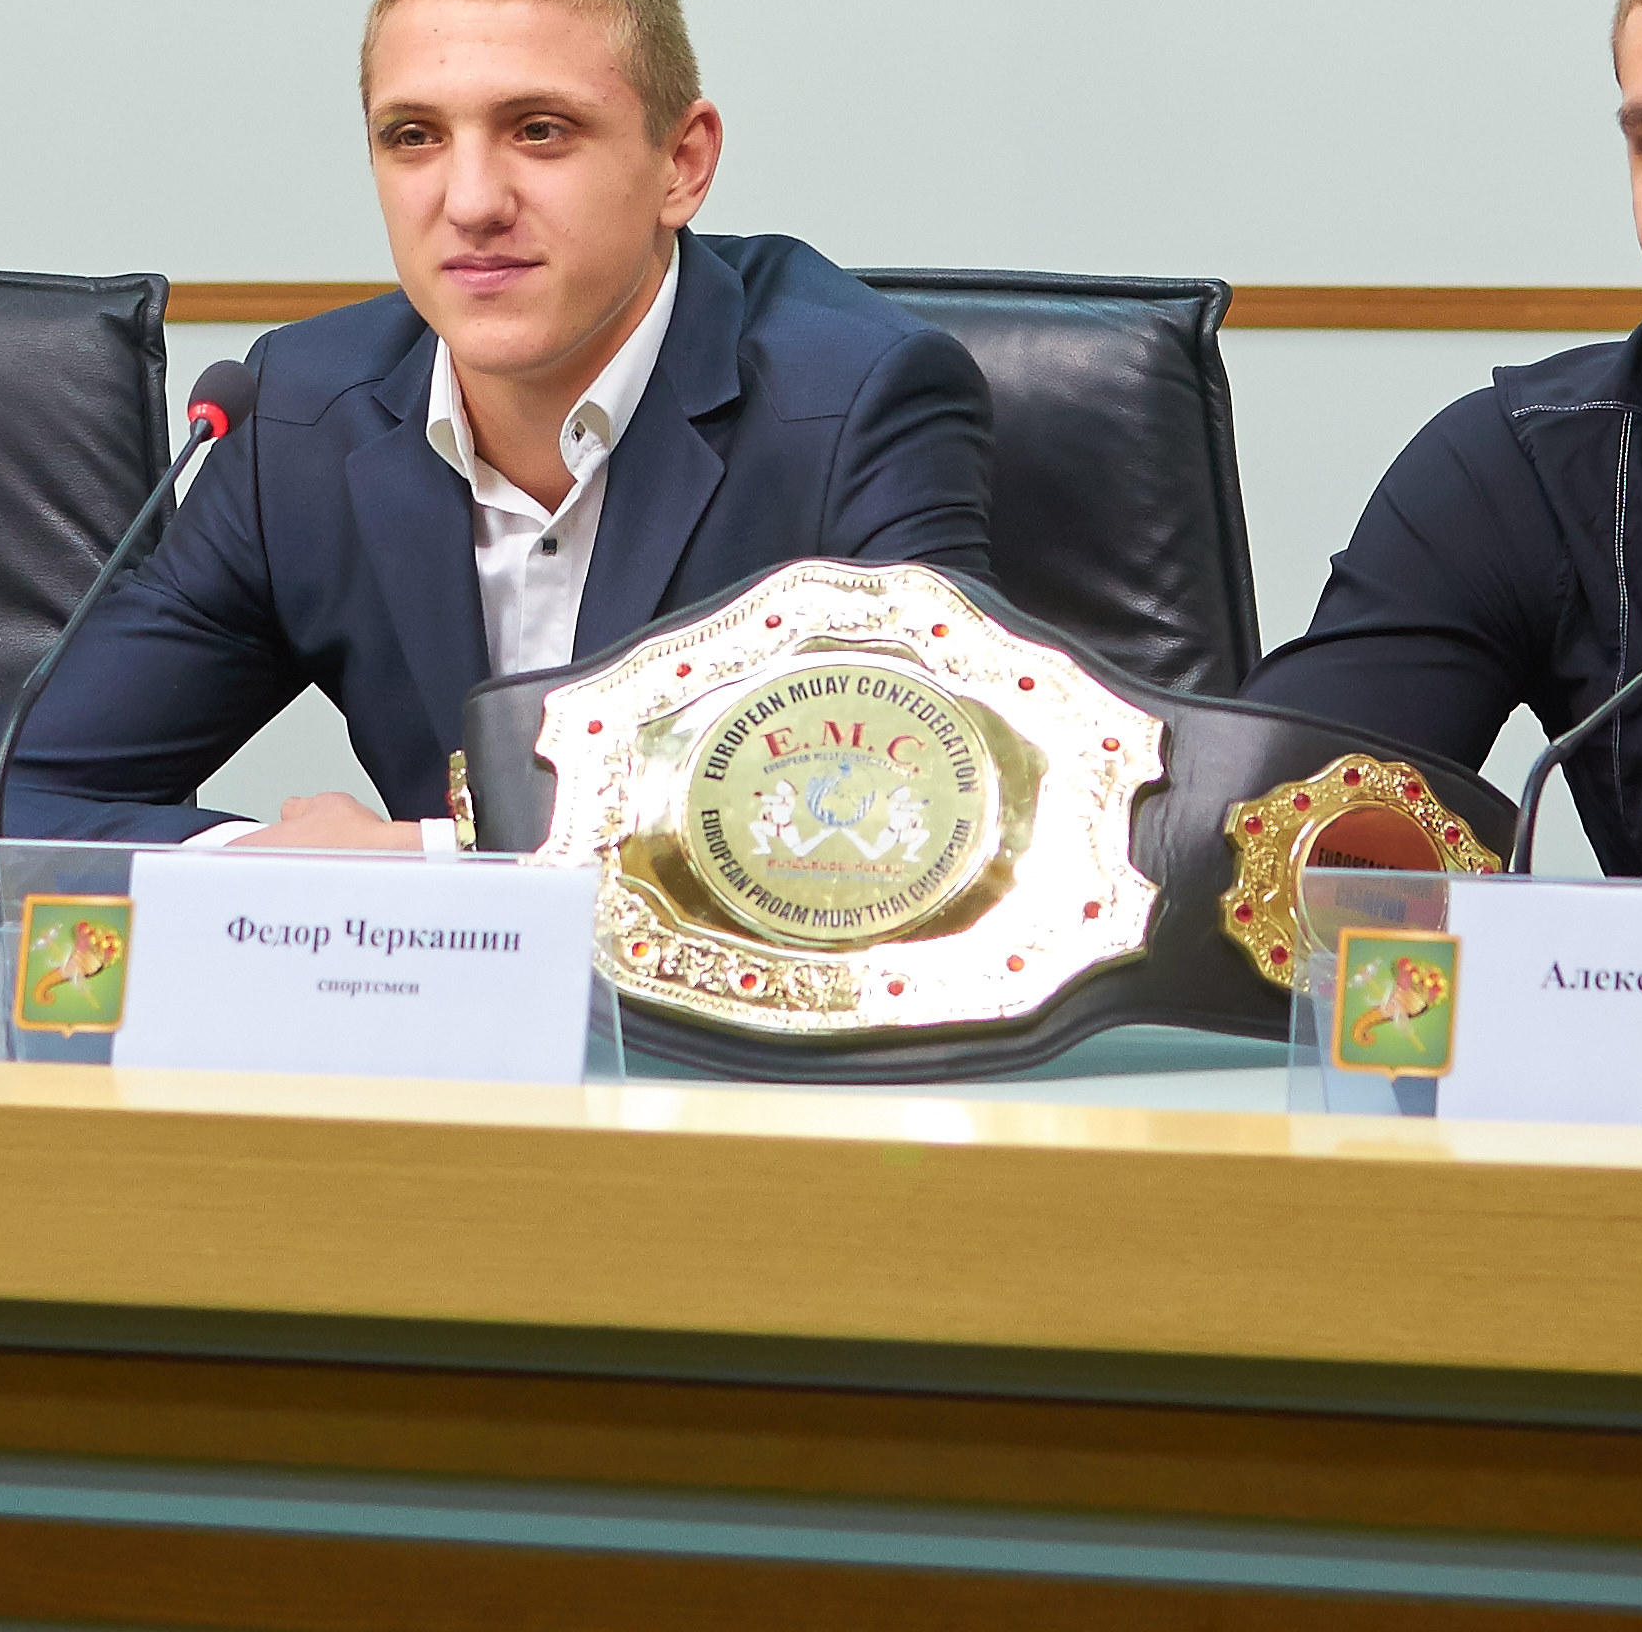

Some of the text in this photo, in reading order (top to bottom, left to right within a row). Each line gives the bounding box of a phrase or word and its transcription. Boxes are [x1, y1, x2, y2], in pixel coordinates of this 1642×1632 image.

[703, 674, 980, 794] EUROPEAN MUAY CONFEDERATION
[700, 808, 752, 891] EUROPEAN
[226, 916, 522, 957] Федор Черкашин
[317, 977, 420, 996] спортсмен
